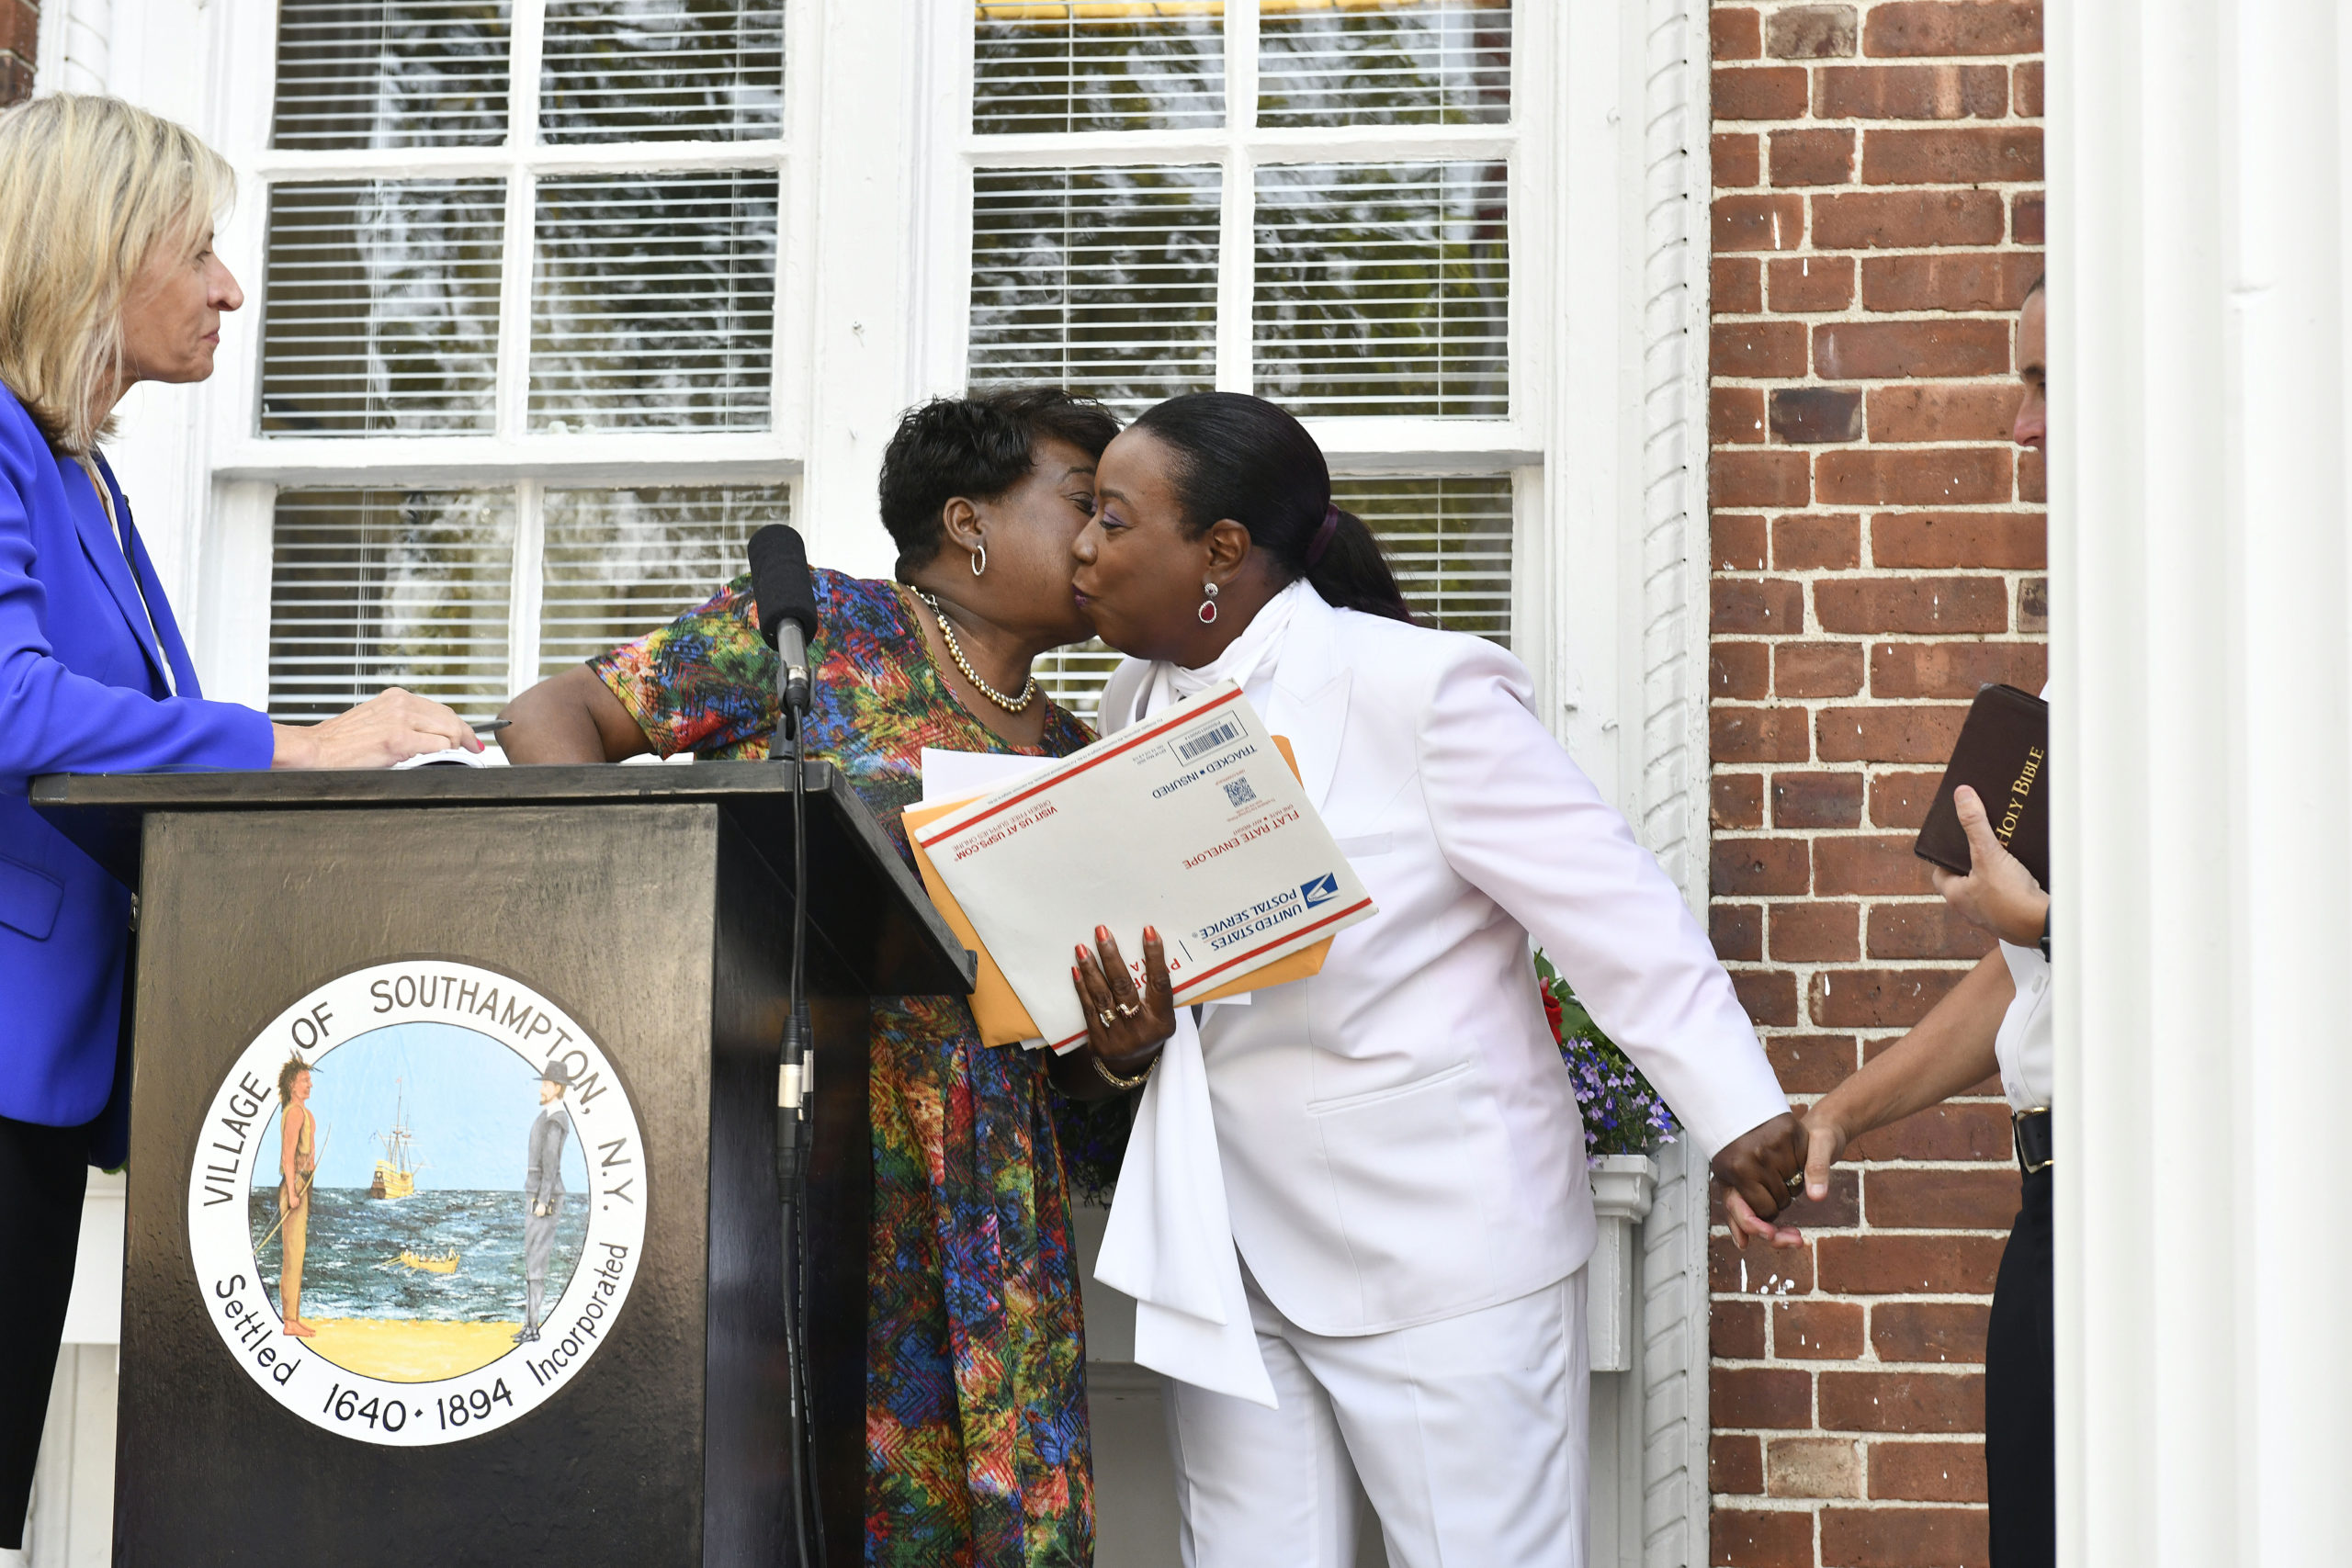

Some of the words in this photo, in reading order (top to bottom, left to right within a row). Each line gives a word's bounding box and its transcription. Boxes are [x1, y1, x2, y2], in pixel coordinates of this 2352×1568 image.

[1204, 743, 1257, 773] TRACKED
[1150, 771, 1199, 799] INSURED
[1996, 797, 2024, 848] HOLY
[2011, 745, 2044, 796] BIBLE
[1017, 817, 1034, 829] US
[1033, 805, 1057, 822] VISIT
[1270, 809, 1300, 829] FLAT
[1004, 824, 1019, 836] AT
[1239, 823, 1271, 842] RATE
[1181, 836, 1240, 870] ENVELOPE
[1249, 887, 1298, 917] POSTAL
[1252, 903, 1304, 931] UNITED
[1208, 924, 1256, 951] STATES
[203, 1071, 271, 1208] VILLAGE
[291, 1001, 334, 1050] OF
[369, 975, 606, 1115] SOUTHAMPTON,
[597, 1137, 634, 1212] N.Y.
[215, 1274, 302, 1387] Settled
[322, 1382, 407, 1433] 1640
[436, 1377, 513, 1429] 1894
[526, 1243, 628, 1388] Incorporated
